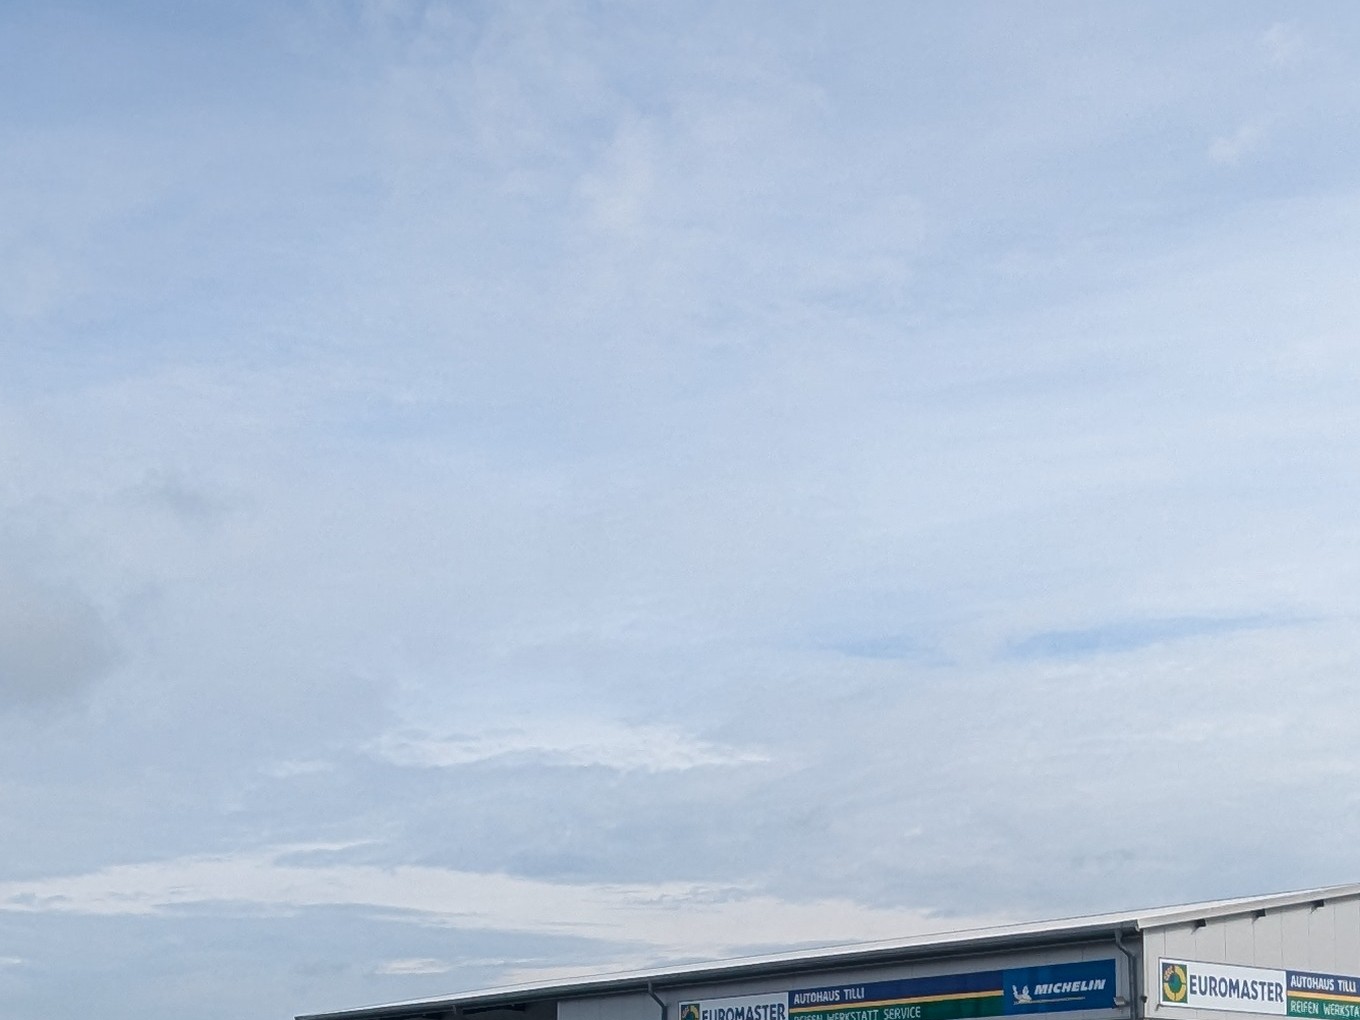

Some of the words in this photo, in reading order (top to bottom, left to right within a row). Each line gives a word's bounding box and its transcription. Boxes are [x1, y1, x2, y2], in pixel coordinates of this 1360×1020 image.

[1034, 979, 1107, 996] MICHELIN
[1189, 975, 1285, 1003] EUROMASTER
[1290, 975, 1335, 992] AUTOHAUS
[1337, 980, 1357, 993] TILLI
[793, 989, 841, 1005] AUTOHAUS
[843, 987, 866, 1001] TILLI
[883, 1006, 921, 1020] SERVICE
[1290, 1000, 1319, 1015] REIFEN
